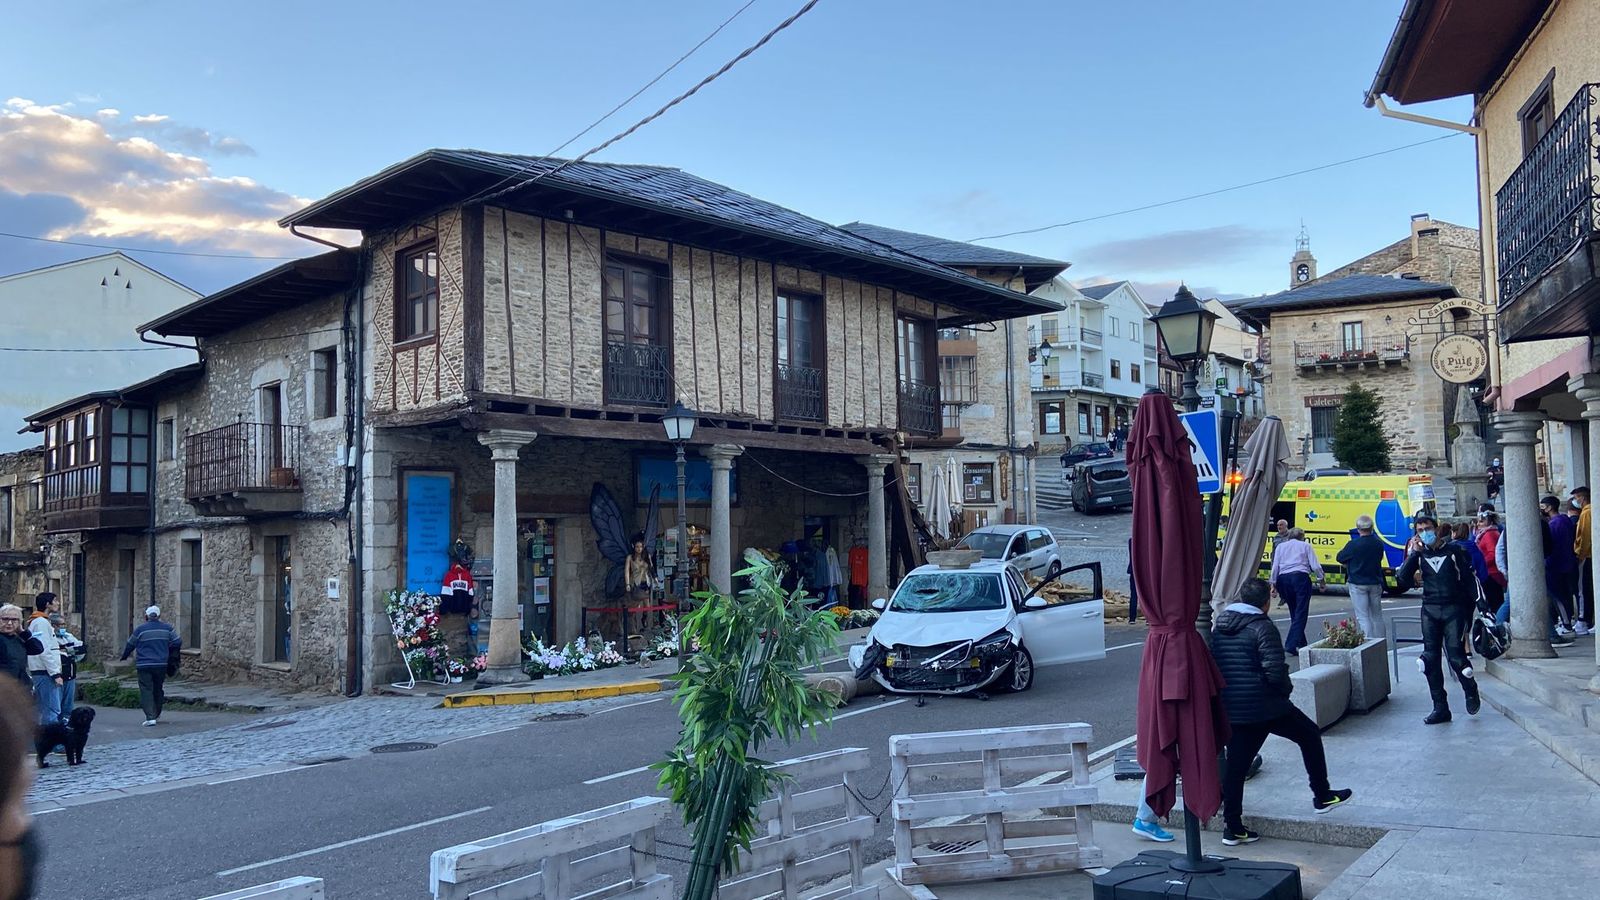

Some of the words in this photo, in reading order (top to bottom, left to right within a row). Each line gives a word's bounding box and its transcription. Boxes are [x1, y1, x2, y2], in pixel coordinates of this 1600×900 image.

[1428, 301, 1455, 316] Salón
[1476, 304, 1488, 312] Té
[1447, 356, 1472, 367] Puig
